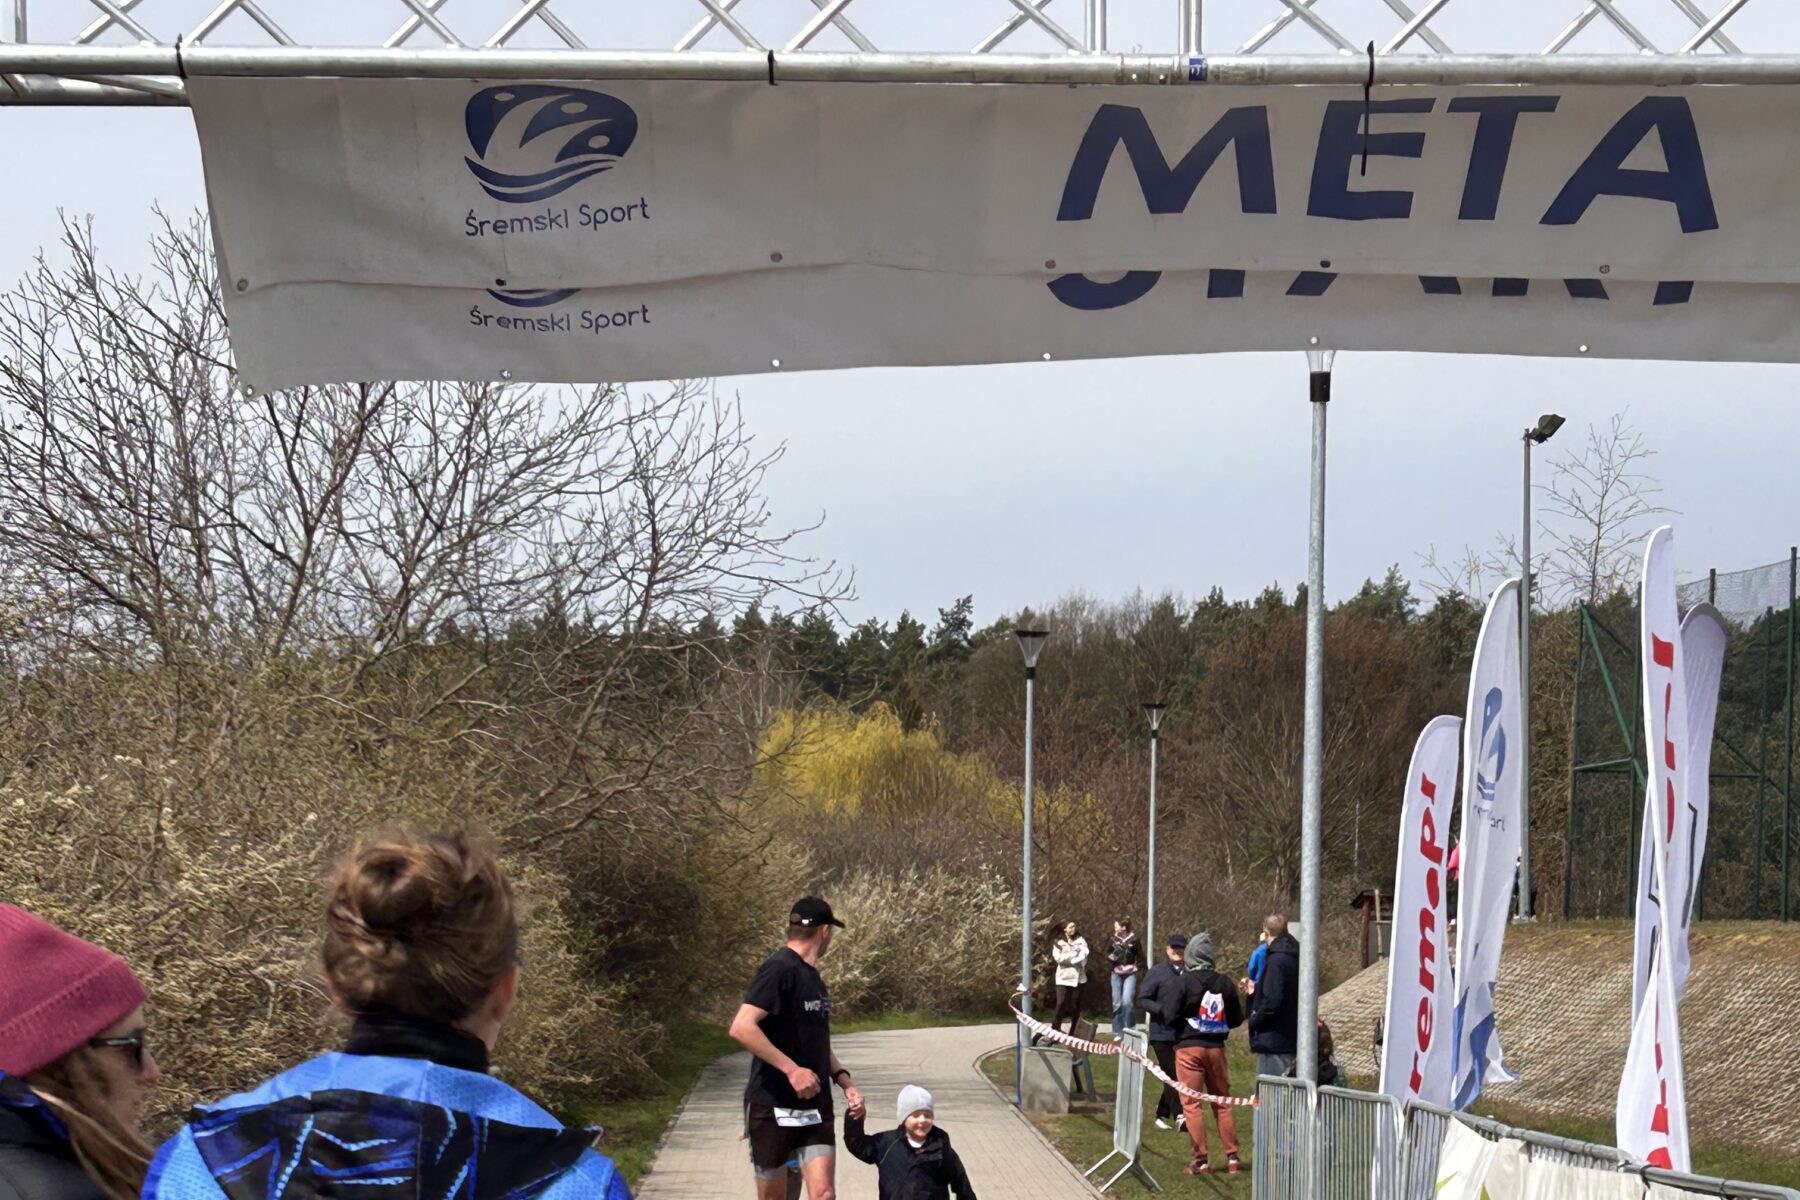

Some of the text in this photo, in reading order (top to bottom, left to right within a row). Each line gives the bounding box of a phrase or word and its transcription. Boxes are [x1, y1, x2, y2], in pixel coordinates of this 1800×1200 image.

[1056, 95, 1719, 233] META
[464, 197, 650, 237] Śremski Sport
[469, 304, 651, 335] Śremski Sport
